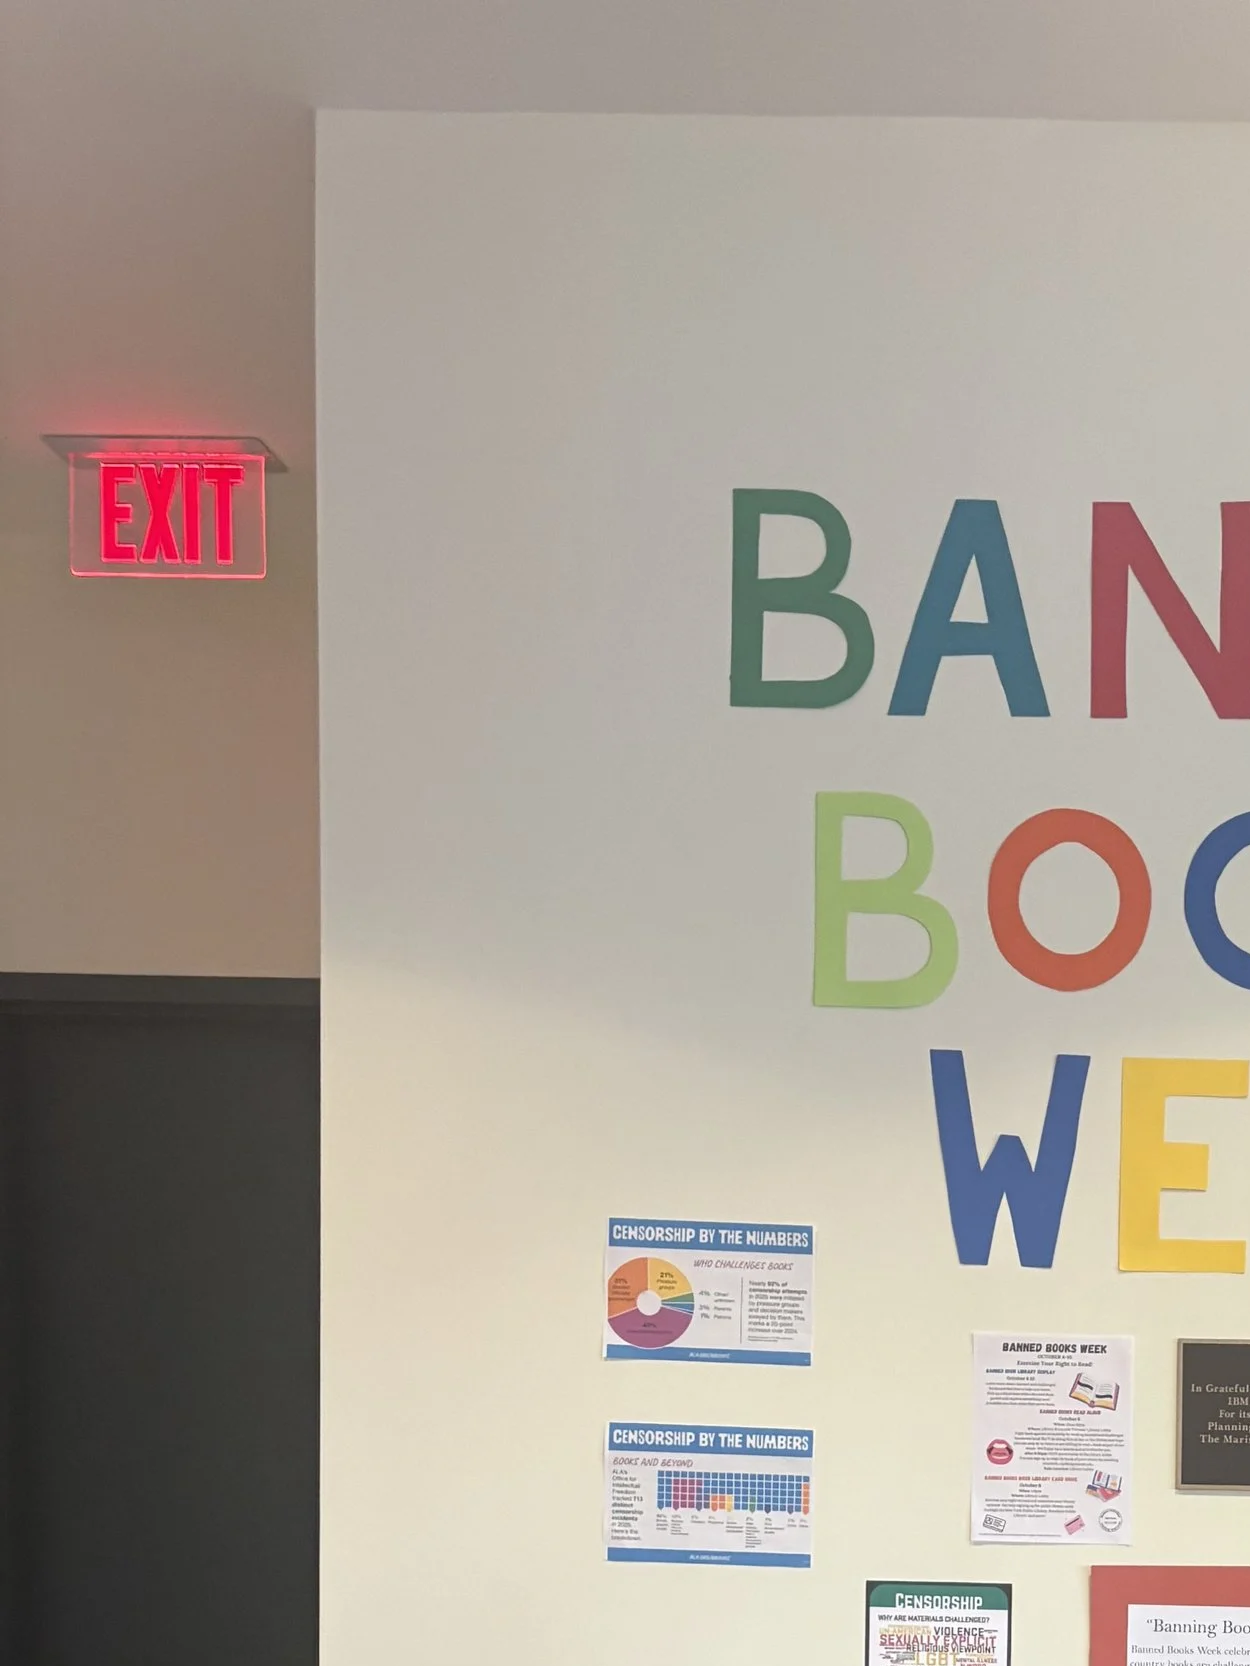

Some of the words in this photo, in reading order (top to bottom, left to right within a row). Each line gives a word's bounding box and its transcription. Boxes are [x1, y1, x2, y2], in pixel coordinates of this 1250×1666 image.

[100, 463, 244, 564] EXIT
[613, 1225, 695, 1243] CENSORSHIP
[699, 1229, 715, 1244] BY
[719, 1230, 742, 1245] THE
[747, 1230, 808, 1248] NUMBERS
[693, 1259, 713, 1268] WHO
[715, 1260, 766, 1270] CHALLENGES
[767, 1262, 793, 1271] BOOKS
[1002, 1343, 1043, 1353] BANNED
[1046, 1344, 1078, 1354] BOOKS
[1080, 1344, 1107, 1354] WEEK
[1191, 1384, 1202, 1393] In
[1206, 1384, 1249, 1394] Grateful
[1228, 1397, 1249, 1406] IBM
[1219, 1410, 1236, 1419] For
[613, 1429, 695, 1447] CENSORSHIP
[699, 1433, 715, 1448] BY
[718, 1434, 743, 1449] THE
[746, 1435, 808, 1451] NUMBERS
[1200, 1435, 1220, 1444] The
[895, 1593, 983, 1610] CENSORSHIP
[934, 1627, 984, 1636] VIOLENCE
[1147, 1619, 1217, 1637] “Banning
[880, 1634, 940, 1646] SEXUALLY
[944, 1636, 997, 1647] EXPLICIT
